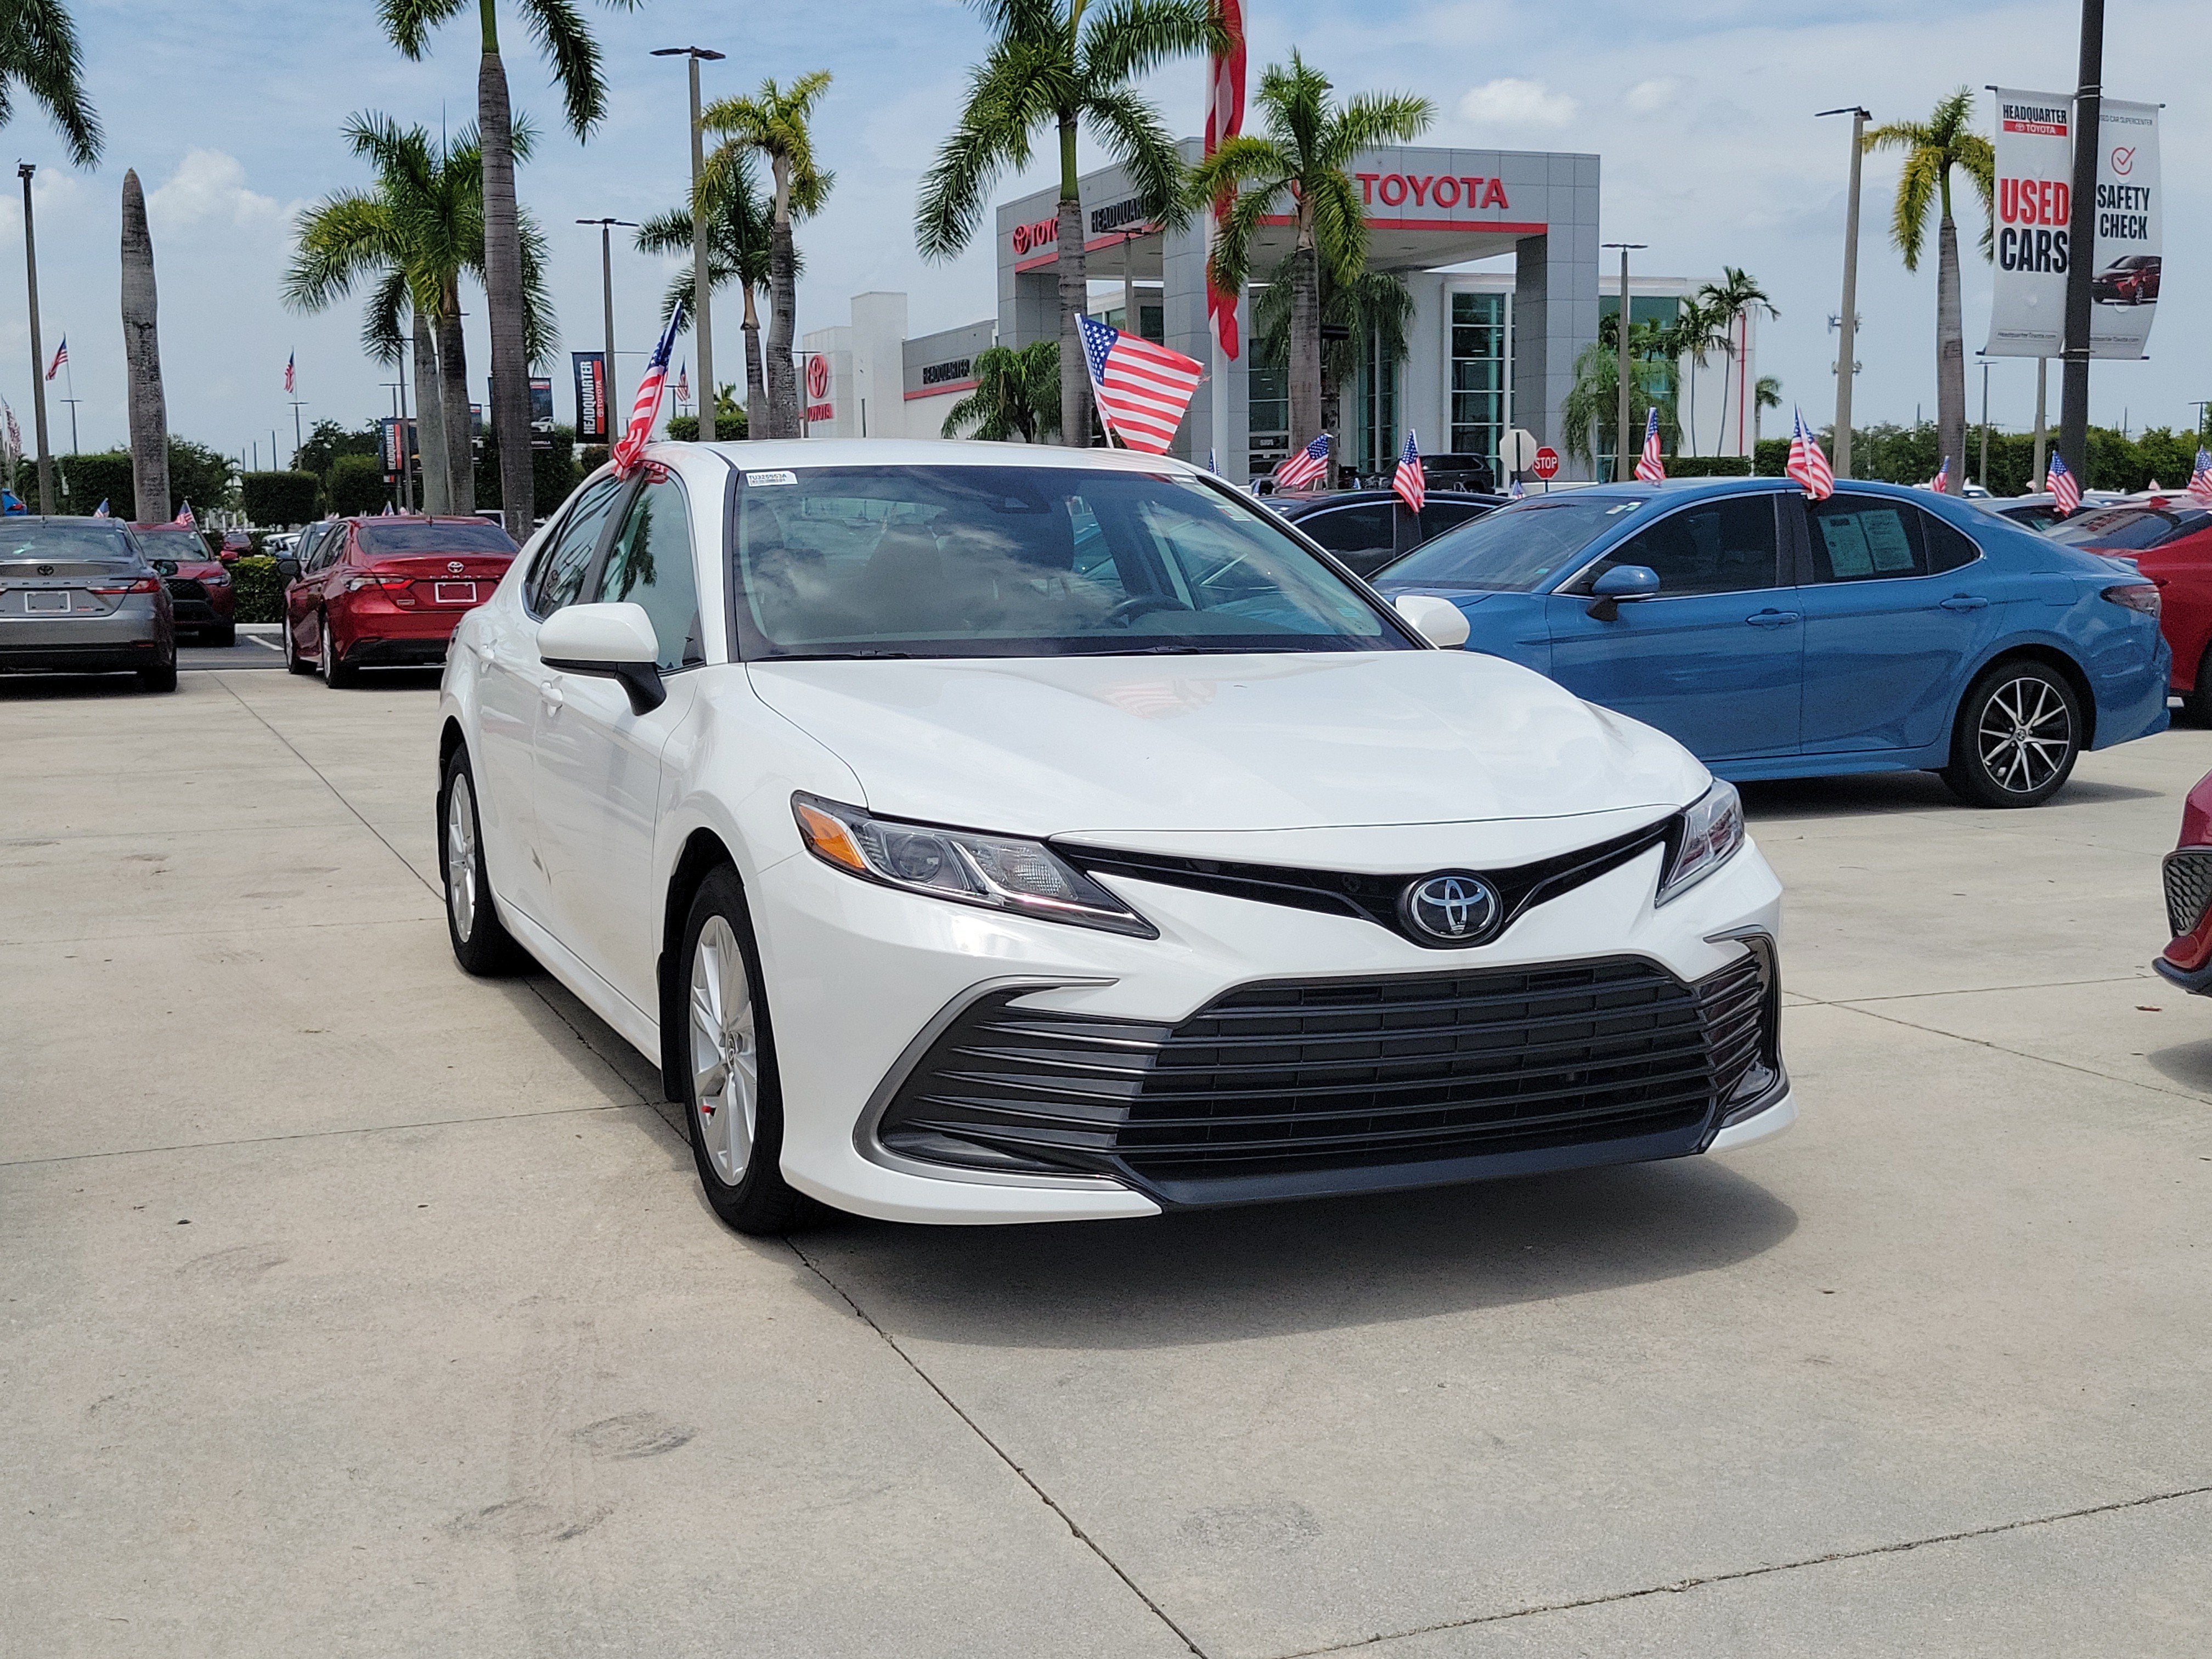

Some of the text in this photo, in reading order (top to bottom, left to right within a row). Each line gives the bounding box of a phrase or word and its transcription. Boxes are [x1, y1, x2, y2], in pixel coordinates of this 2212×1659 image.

[2003, 104, 2067, 124] HEADQUARTER
[2027, 122, 2056, 134] TOYOTA
[1356, 173, 1509, 209] TOYOTA
[2000, 178, 2069, 226] USED
[2097, 184, 2150, 211] SAFETY
[2100, 213, 2148, 240] CHECK
[2000, 227, 2068, 273] CARS
[580, 361, 595, 435] HEADQUARTER
[386, 424, 396, 470] HEADQUARTER
[1534, 457, 1558, 469] STOP
